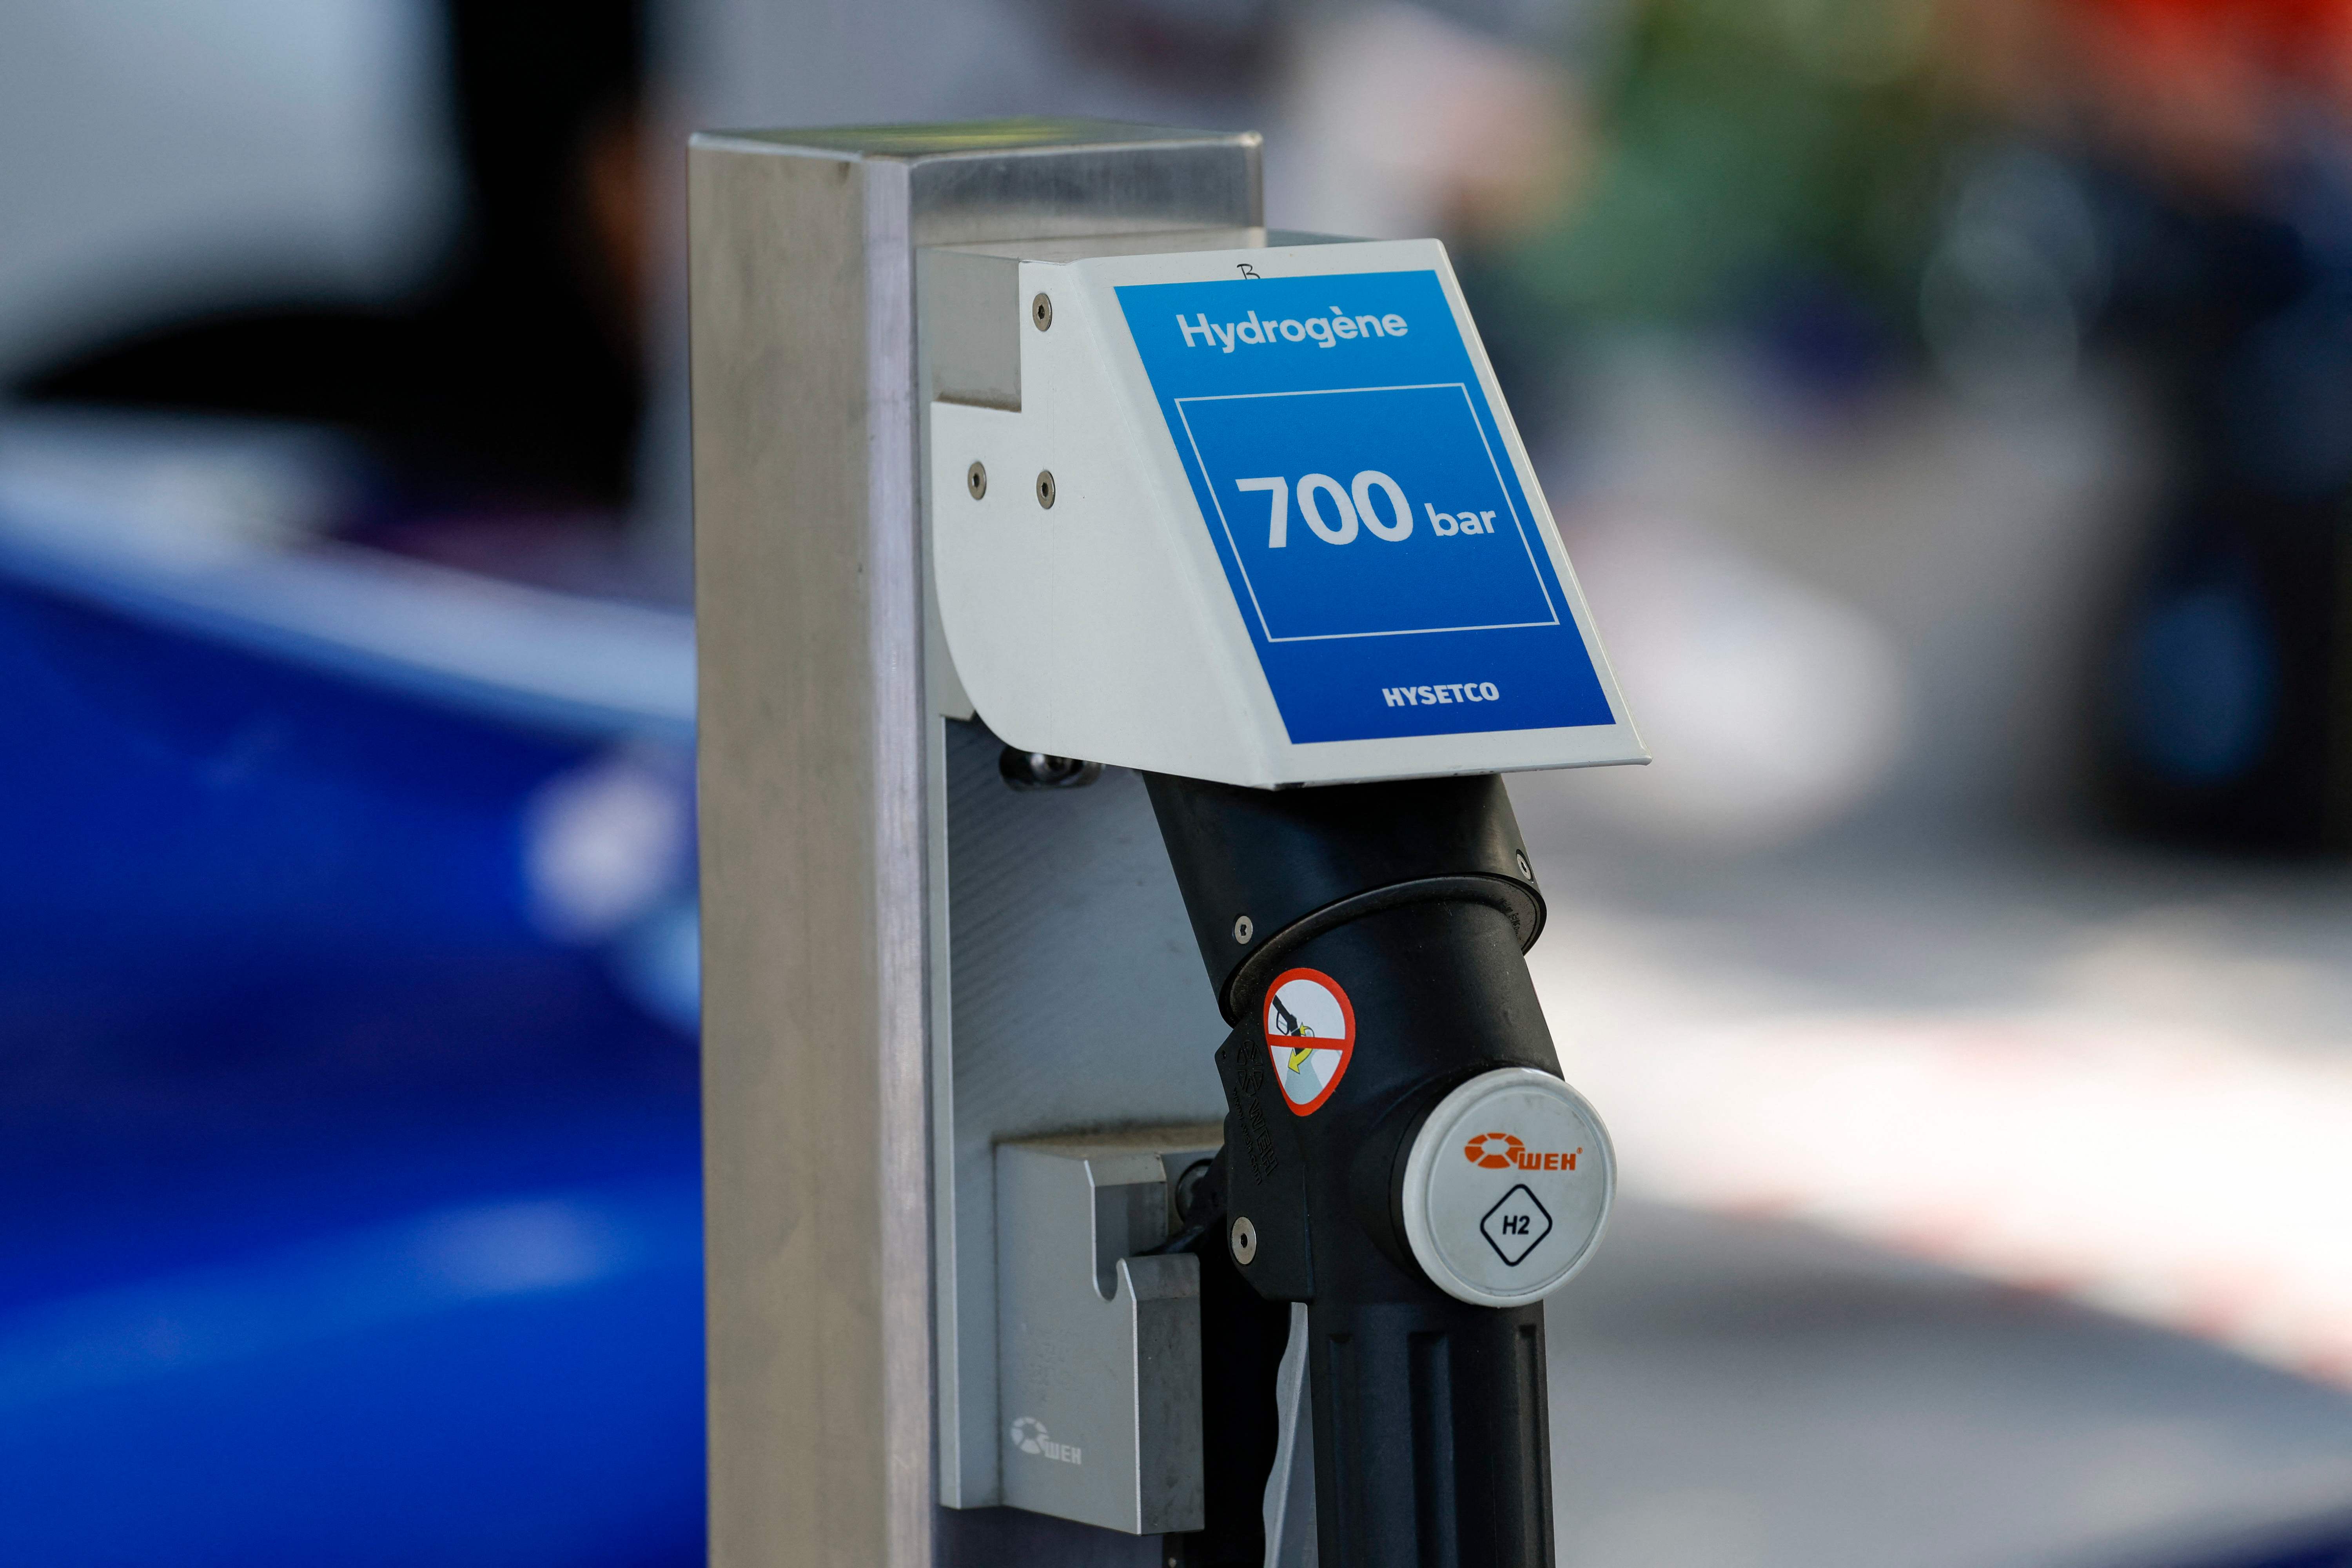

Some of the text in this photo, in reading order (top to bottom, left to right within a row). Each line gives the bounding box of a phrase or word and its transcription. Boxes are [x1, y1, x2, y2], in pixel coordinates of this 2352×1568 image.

[1176, 306, 1408, 353] Hydrogène
[1236, 470, 1496, 548] 700 bar
[1382, 682, 1499, 706] HYSETCO
[1503, 1216, 1530, 1234] H2
[1044, 1441, 1082, 1465] WEH
